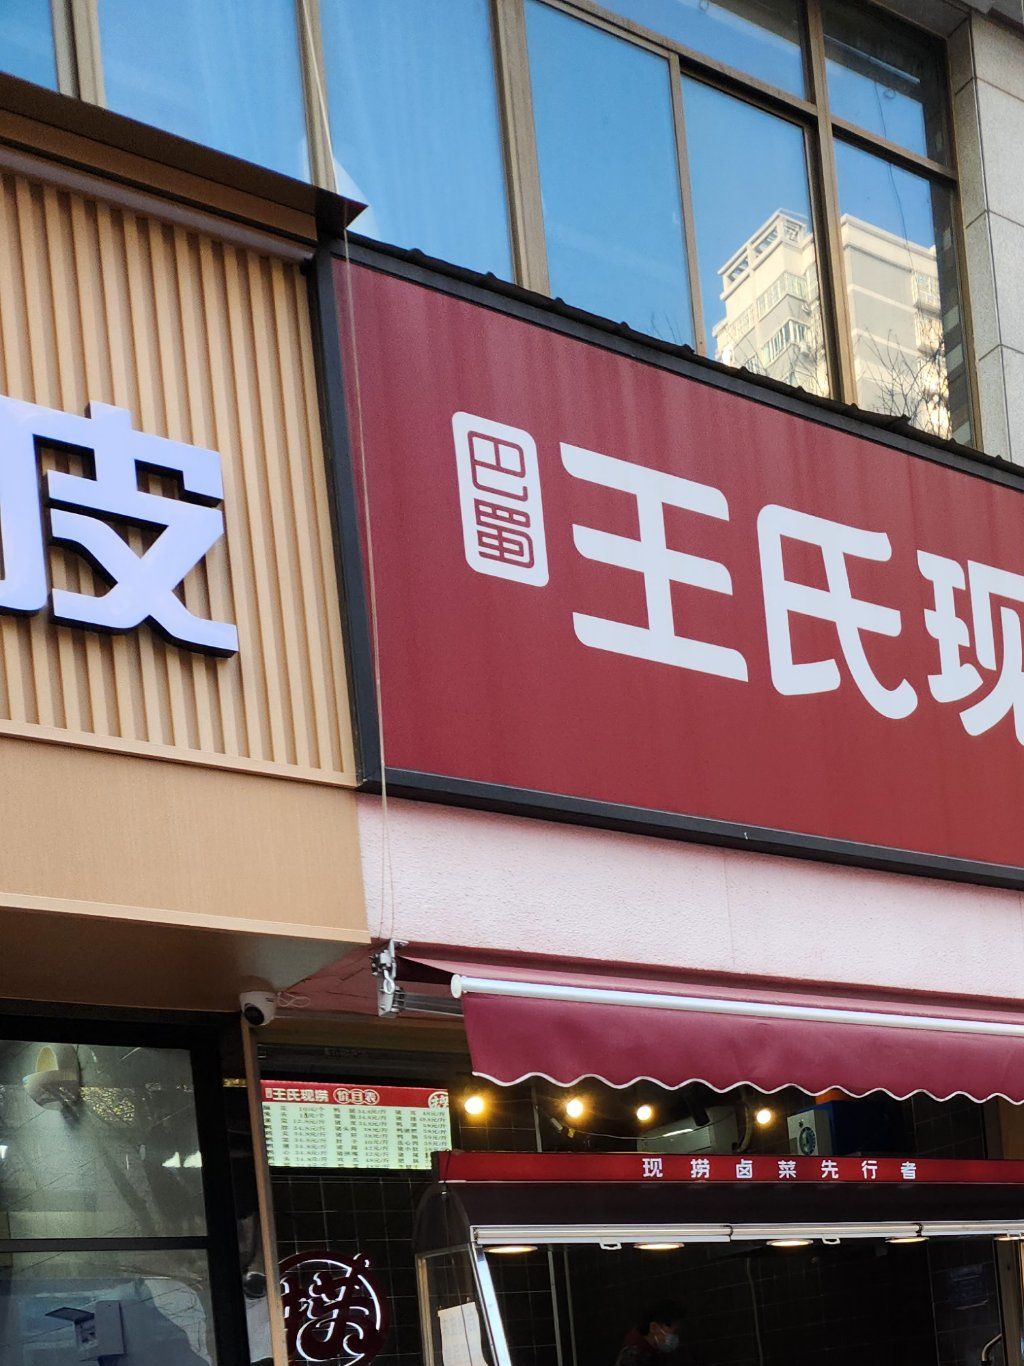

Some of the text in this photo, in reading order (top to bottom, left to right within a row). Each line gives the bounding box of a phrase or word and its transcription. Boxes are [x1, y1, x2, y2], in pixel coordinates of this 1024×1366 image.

[272, 1087, 329, 1102] 王氏现捞
[642, 1157, 917, 1180] 现捞卤菜先行者
